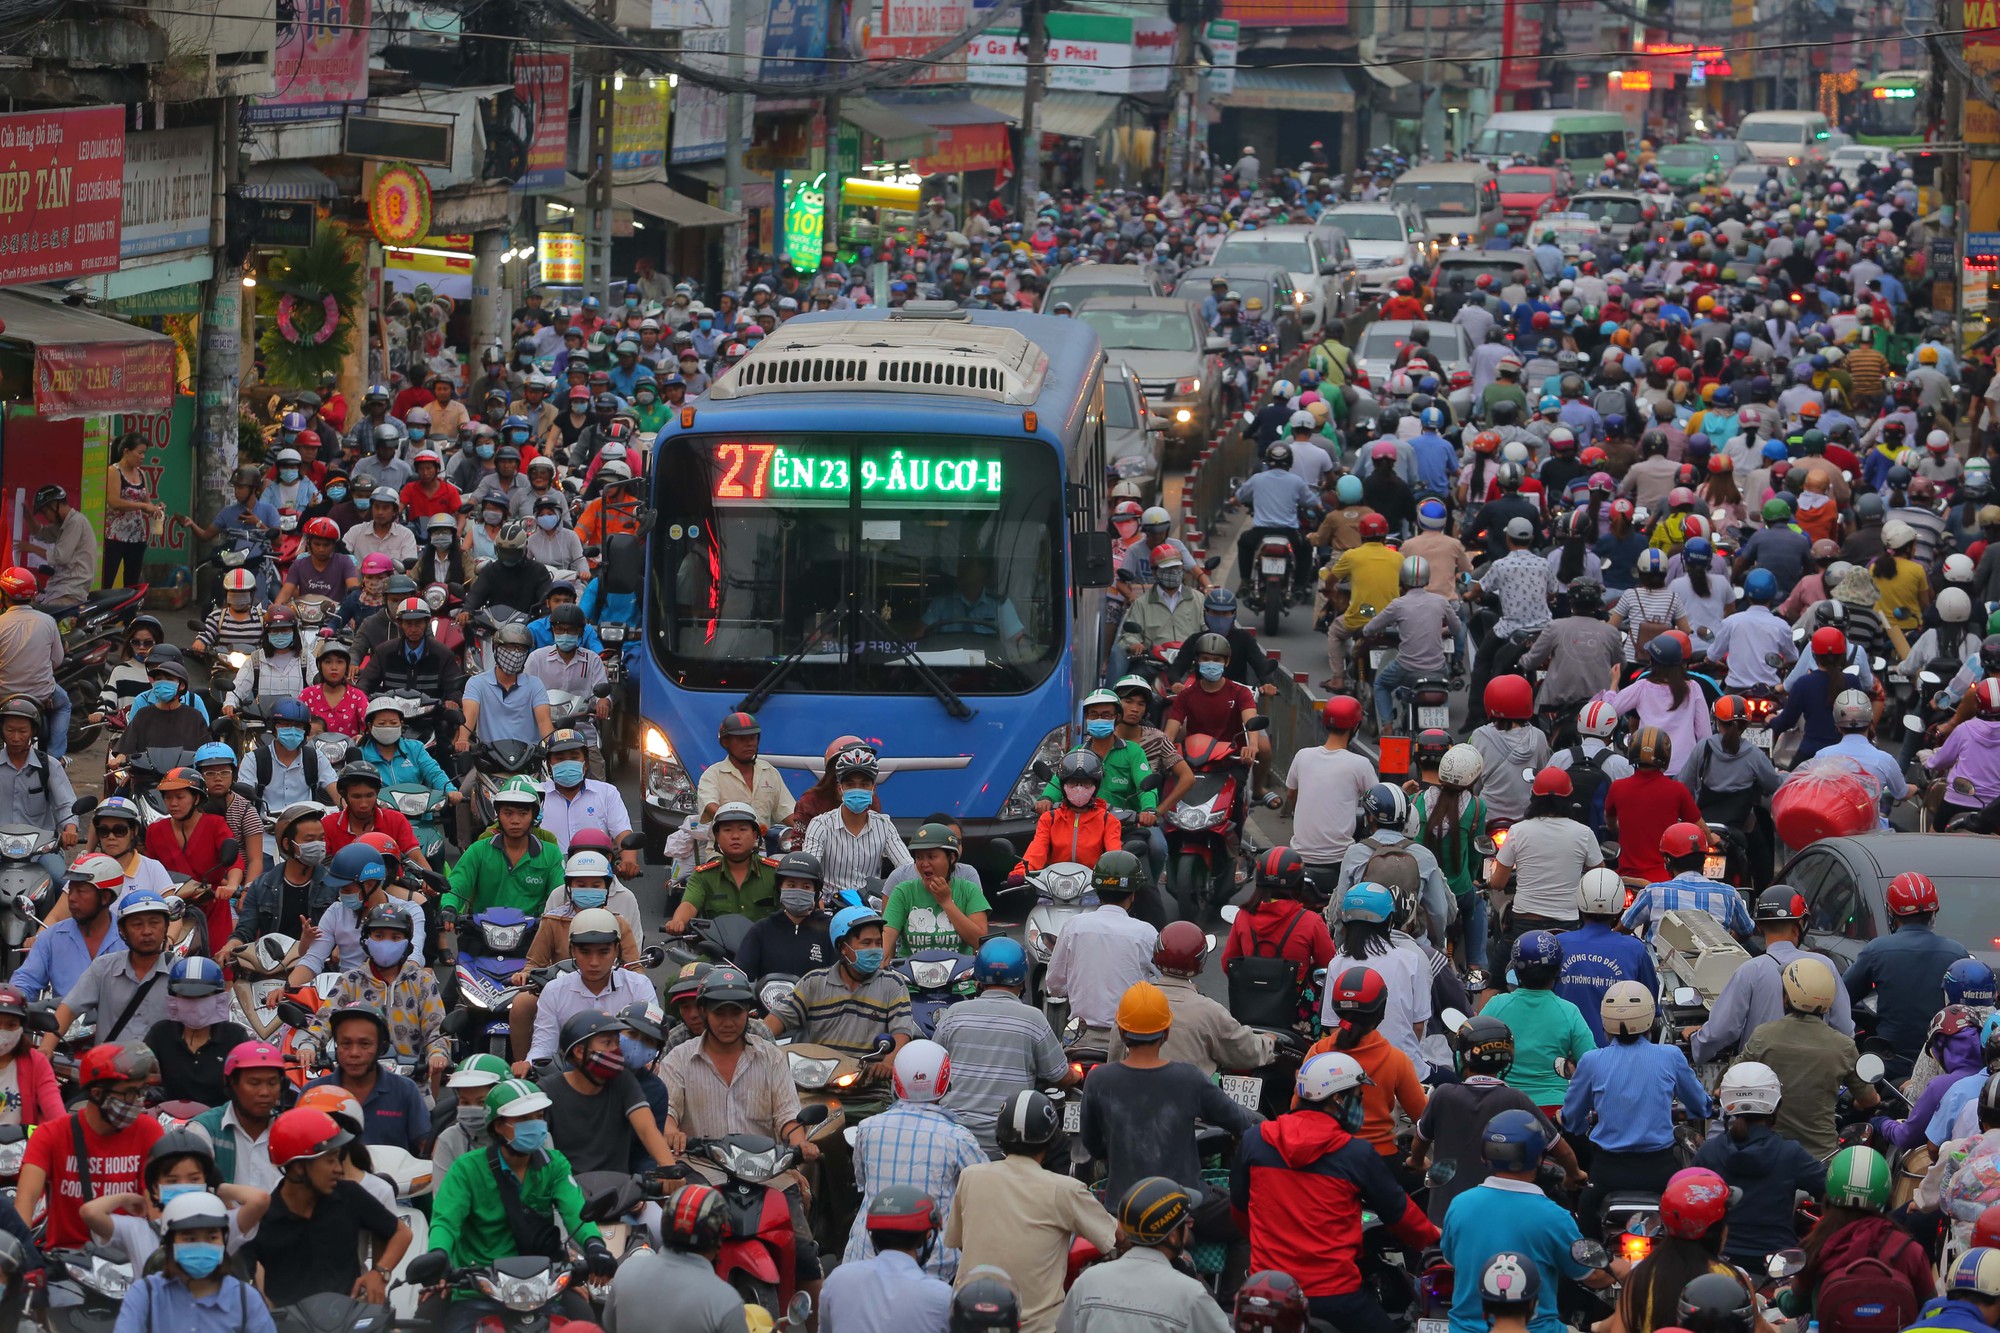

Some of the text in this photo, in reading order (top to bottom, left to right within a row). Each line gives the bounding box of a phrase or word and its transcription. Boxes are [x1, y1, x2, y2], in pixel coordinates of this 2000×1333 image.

[987, 40, 1006, 54] Ga
[1065, 46, 1098, 61] Phát
[16, 126, 34, 152] Hàng
[36, 118, 46, 145] Đồ
[79, 132, 122, 160] LED QUẢNG CÁO
[36, 157, 73, 210] TÂN
[76, 173, 121, 203] LED CHIẾU SÁNG
[74, 224, 86, 244] LED
[86, 221, 106, 243] TRANG
[86, 361, 111, 390] TÂN
[717, 443, 776, 498] 27
[1111, 776, 1129, 785] Grab
[363, 868, 382, 877] UBER
[525, 875, 544, 885] Grab
[906, 934, 932, 945] LINE
[1561, 953, 1623, 977] TRƯỜNG CAO ĐẲNG
[1571, 973, 1592, 985] THÔNG
[1592, 976, 1605, 988] VẬN
[1223, 1078, 1255, 1094] 59-G2
[60, 1179, 102, 1199] COOS'
[1149, 1202, 1182, 1233] STANLEY
